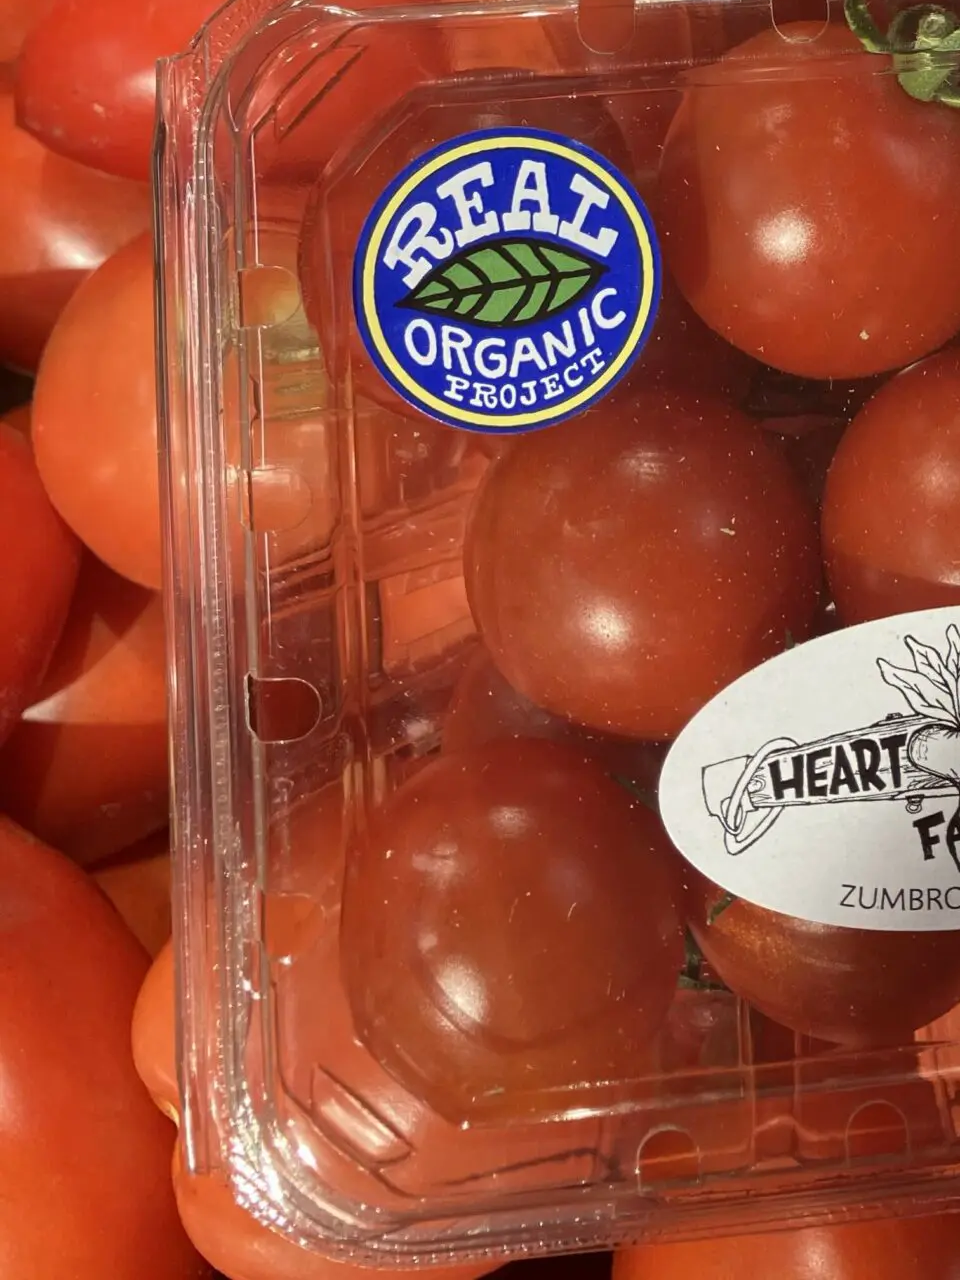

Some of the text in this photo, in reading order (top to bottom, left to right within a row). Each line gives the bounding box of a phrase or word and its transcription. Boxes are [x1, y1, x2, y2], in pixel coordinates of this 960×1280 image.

[383, 159, 619, 290] REAL
[404, 288, 627, 379] ORGANIC
[443, 347, 605, 409] PROJECT
[768, 732, 909, 800] HEART
